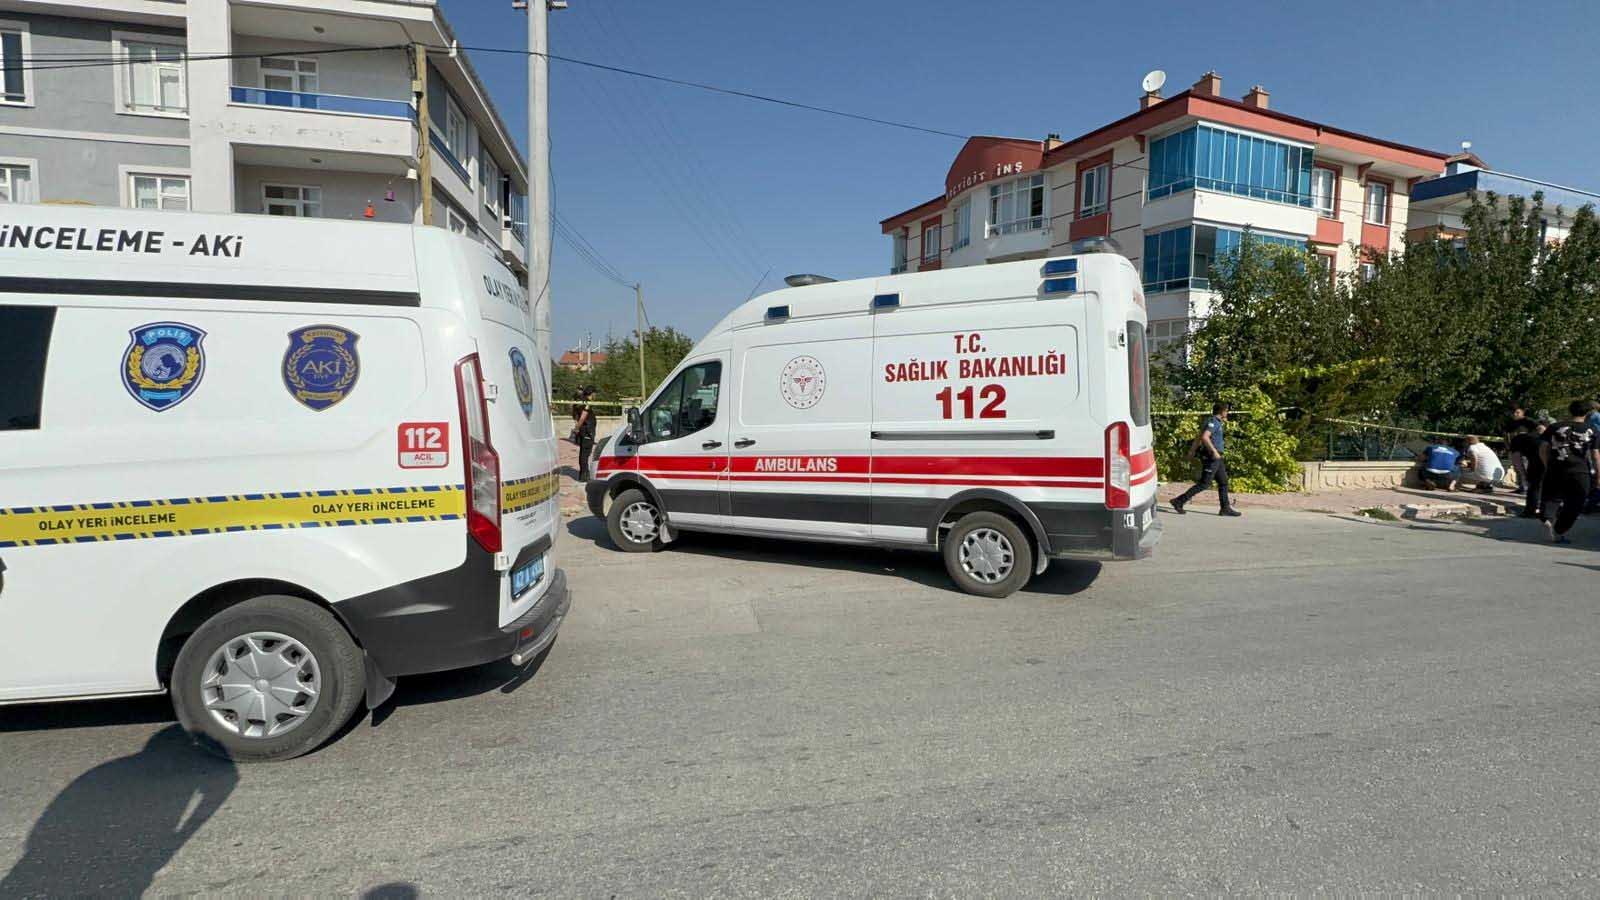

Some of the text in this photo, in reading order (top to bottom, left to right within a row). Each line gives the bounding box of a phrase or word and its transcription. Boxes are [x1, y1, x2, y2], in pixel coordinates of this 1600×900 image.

[954, 333, 986, 354] T.C.
[885, 350, 1066, 383] SAĞLIK BAKANLIĞI
[935, 383, 1007, 420] 112
[405, 427, 442, 449] 112
[755, 457, 838, 473] AMBULANS
[313, 503, 344, 514] OLAY
[38, 518, 74, 531] OLAY
